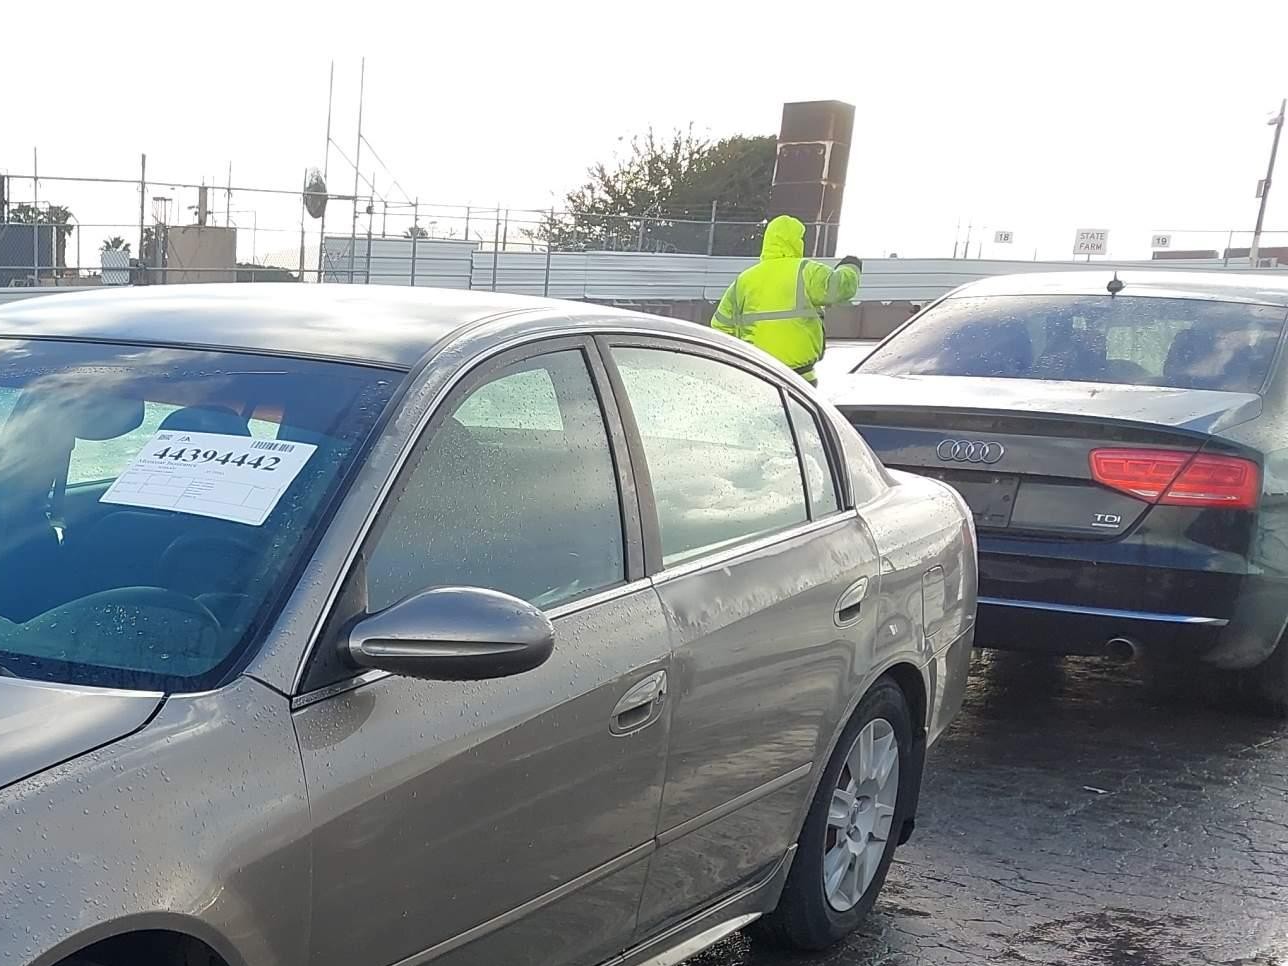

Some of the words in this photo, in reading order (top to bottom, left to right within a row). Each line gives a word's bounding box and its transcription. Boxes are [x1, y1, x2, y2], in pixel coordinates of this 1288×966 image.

[998, 233, 1010, 241] 18
[1079, 232, 1105, 241] STATE
[1155, 237, 1167, 245] 19
[1078, 242, 1103, 251] FARM
[153, 446, 281, 471] 44394442
[1093, 513, 1121, 523] TDI
